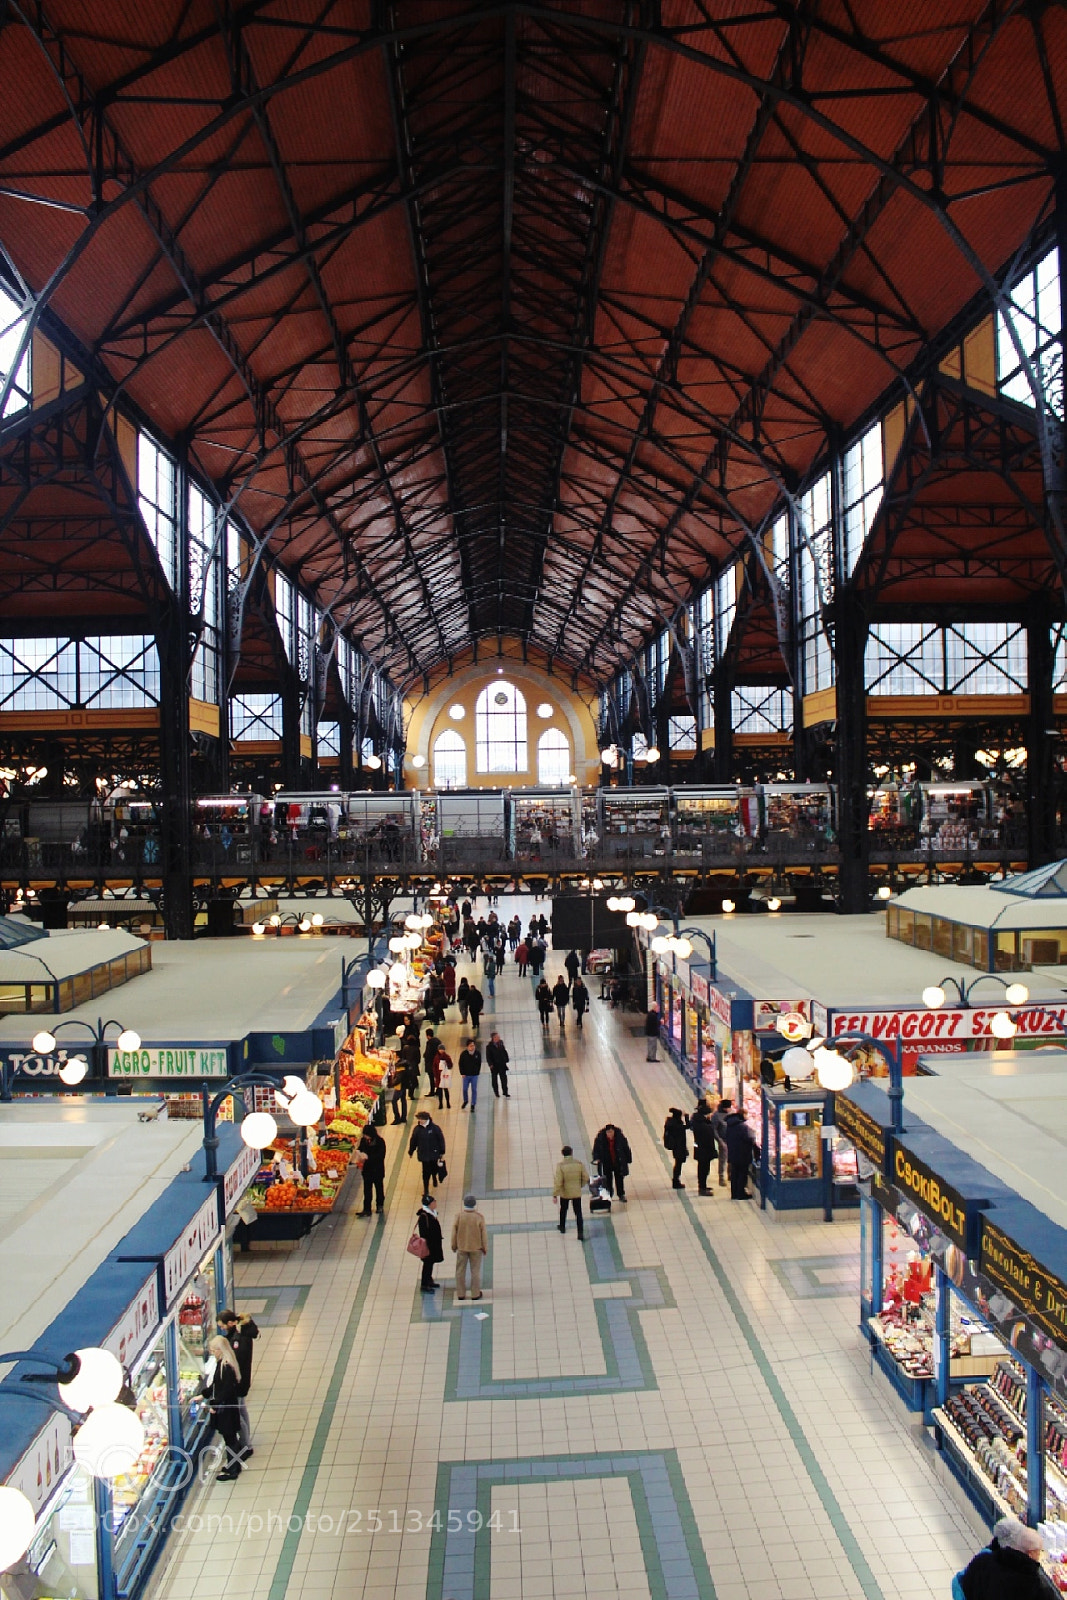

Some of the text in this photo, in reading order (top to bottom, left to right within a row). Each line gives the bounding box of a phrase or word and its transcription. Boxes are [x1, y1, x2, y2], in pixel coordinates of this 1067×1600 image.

[834, 1011, 964, 1038] FELVÁGOTT
[901, 1044, 962, 1054] KABANOS
[113, 1050, 227, 1075] AGRO-FRUIT KFT.
[982, 1234, 1067, 1327] Chocolate & Dri
